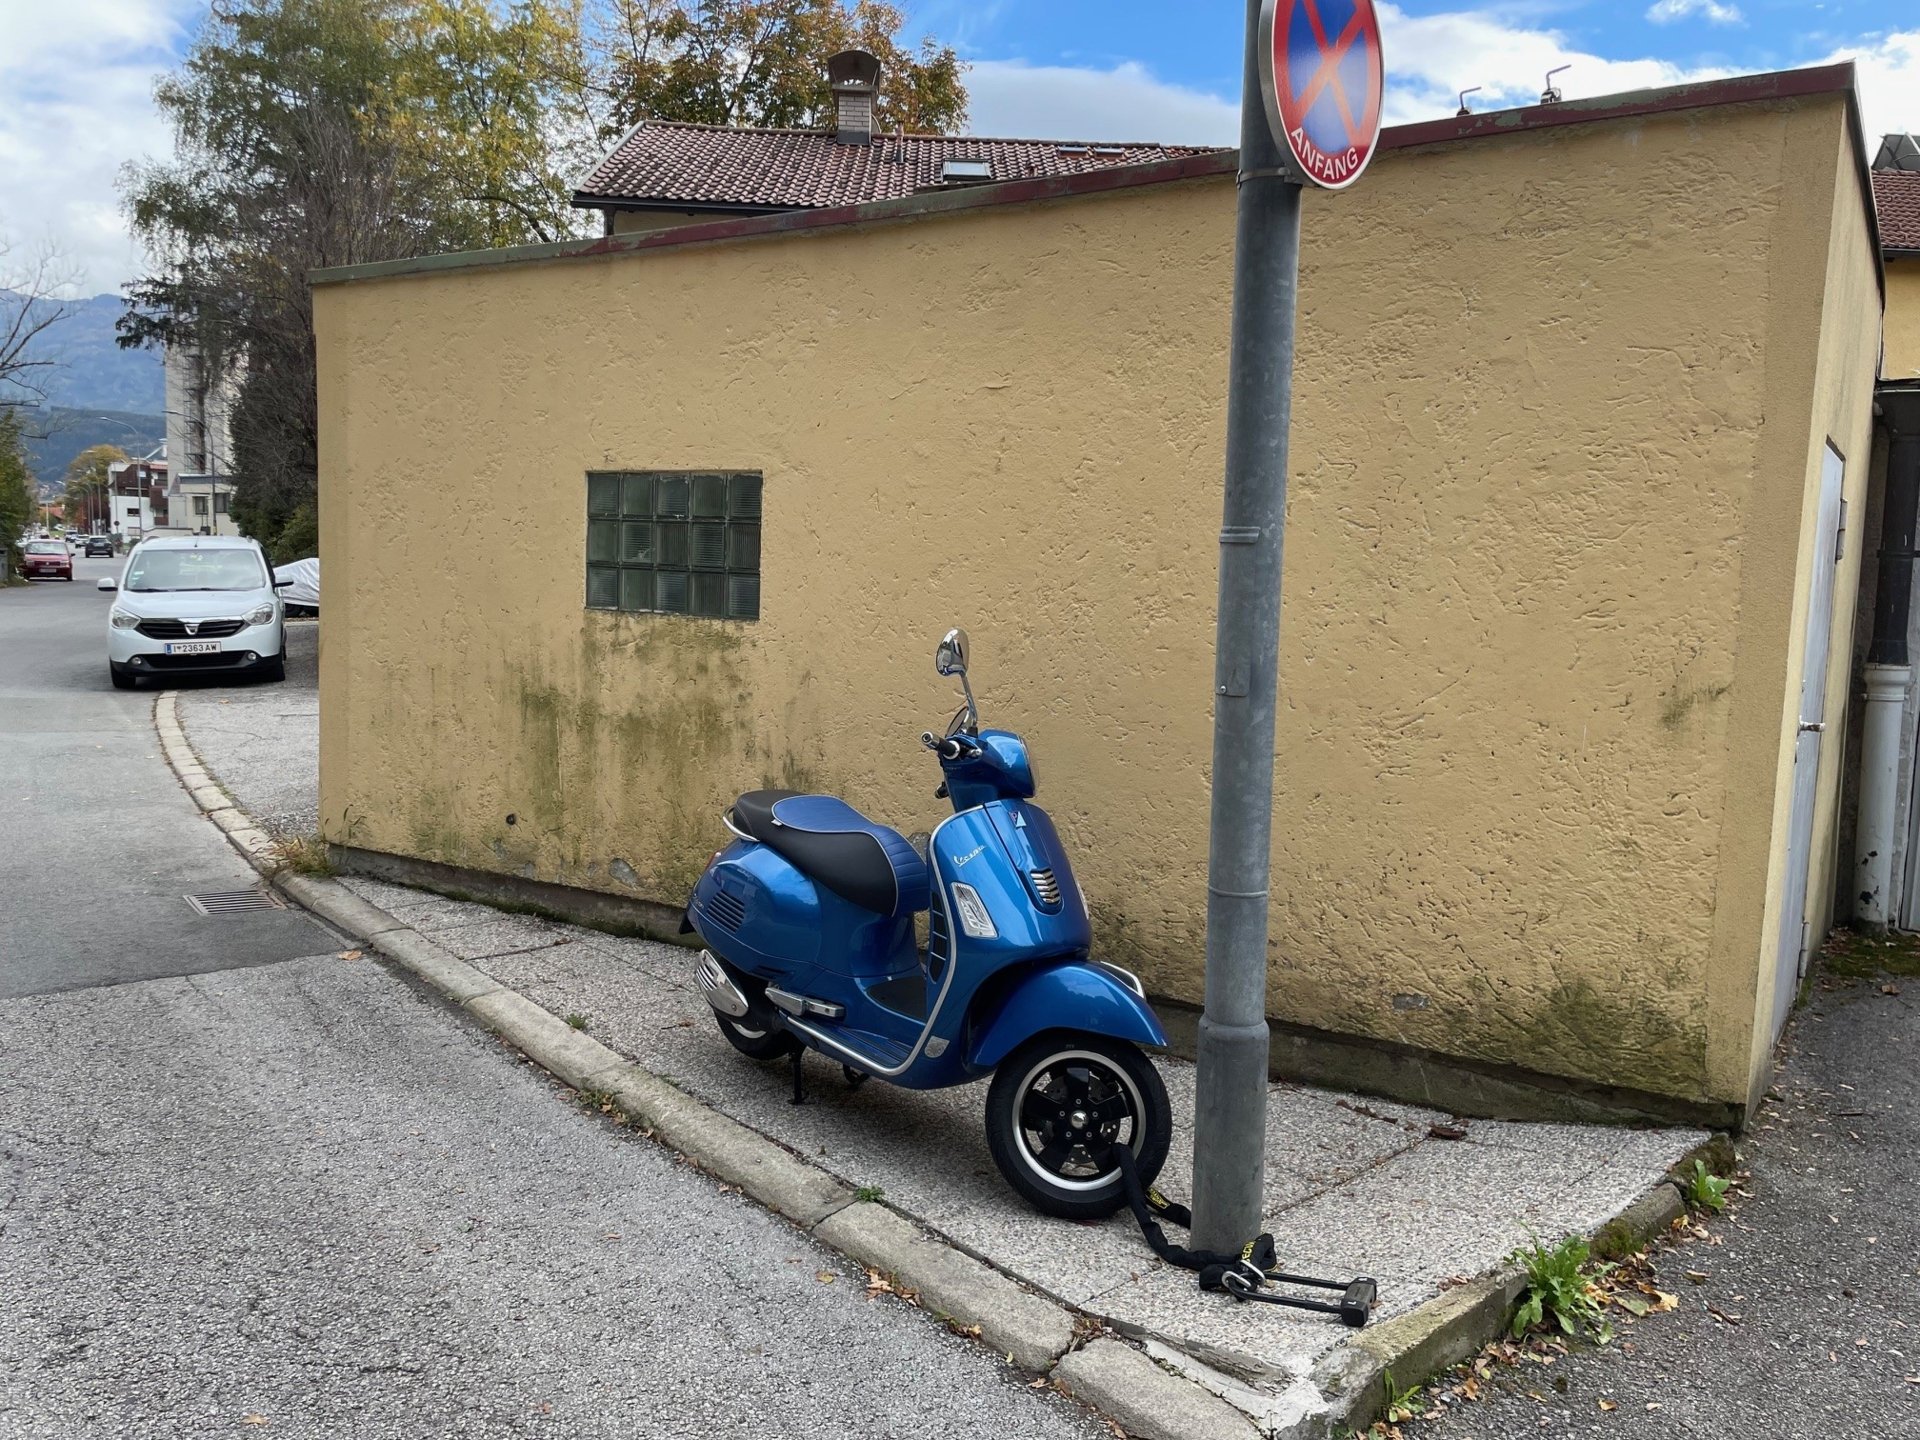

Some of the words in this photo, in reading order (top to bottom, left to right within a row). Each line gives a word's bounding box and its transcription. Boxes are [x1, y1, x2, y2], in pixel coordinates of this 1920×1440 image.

[1291, 127, 1358, 180] ANFANG
[182, 644, 204, 653] 2363
[205, 643, 217, 652] AW
[953, 845, 986, 867] Vespa
